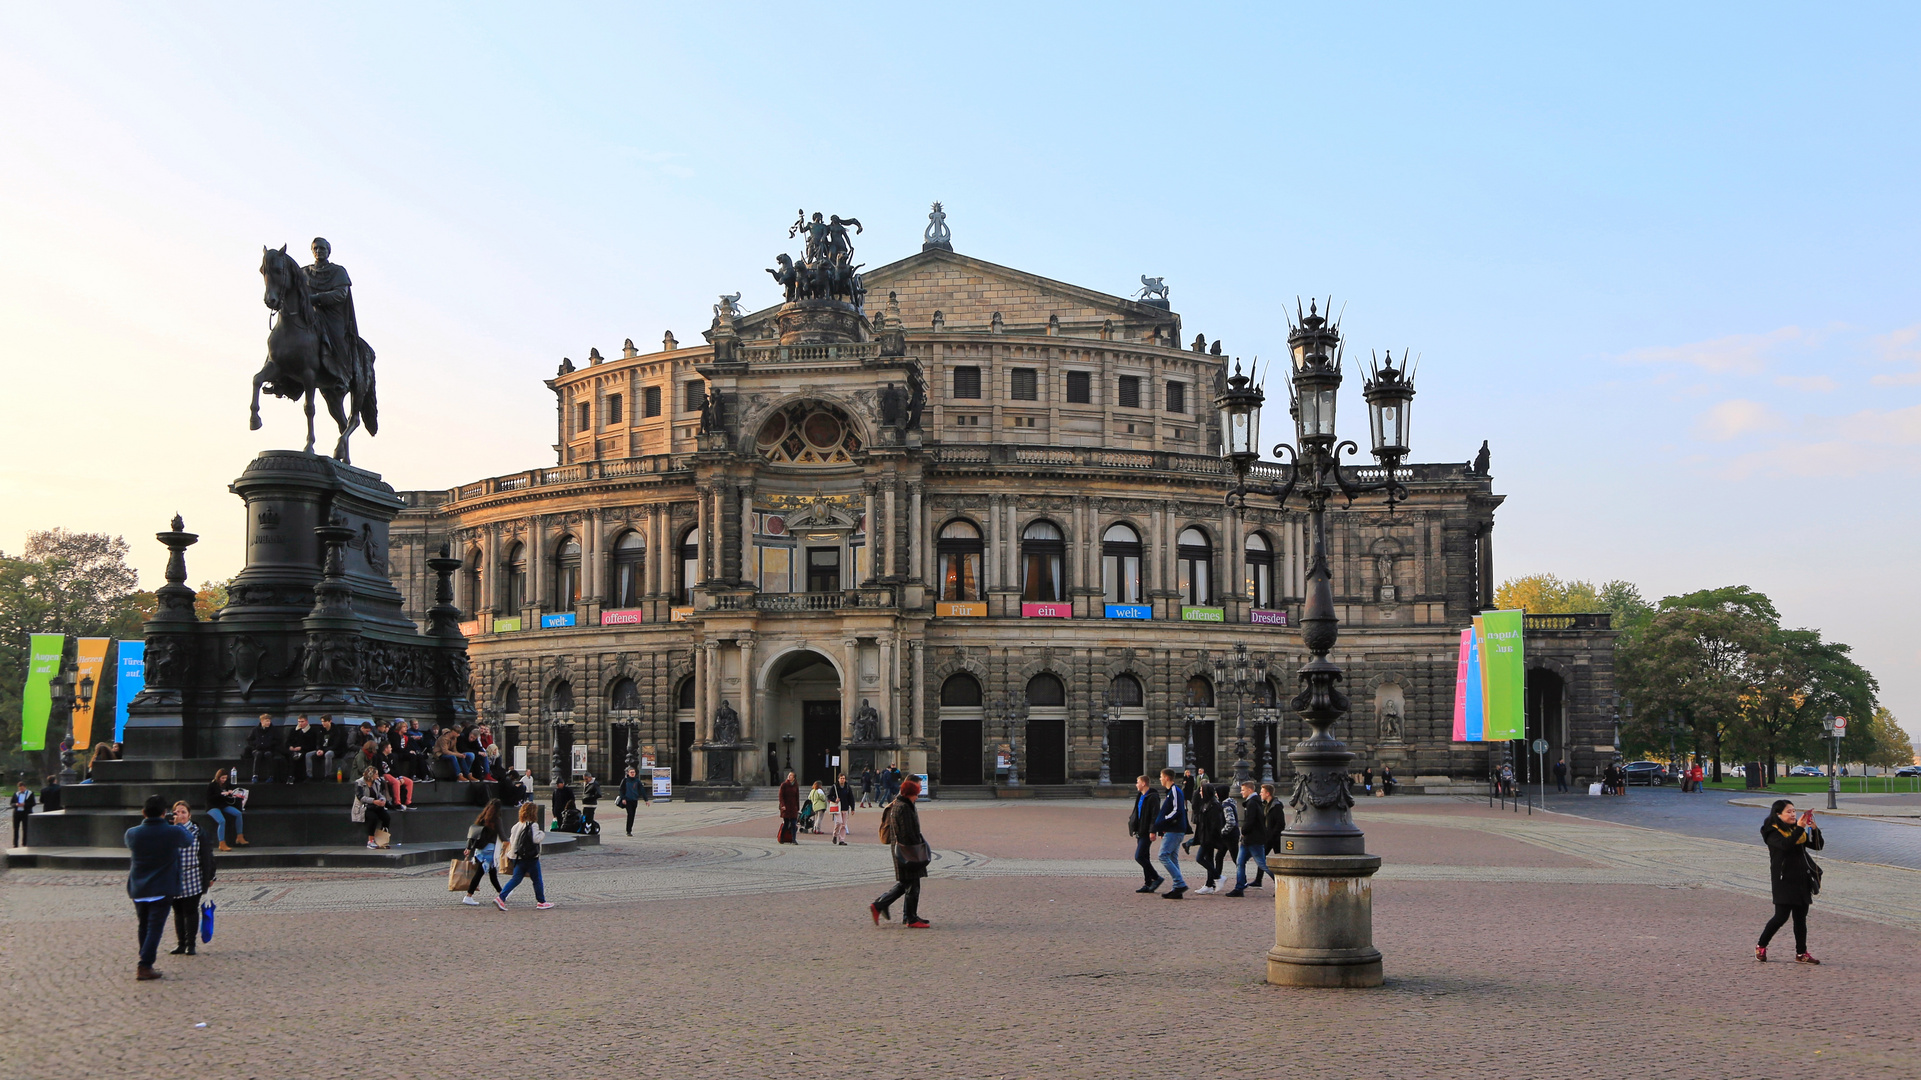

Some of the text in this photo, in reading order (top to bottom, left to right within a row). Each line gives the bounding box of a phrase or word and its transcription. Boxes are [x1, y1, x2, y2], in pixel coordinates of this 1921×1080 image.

[951, 604, 1286, 624] Für ein welt- offenes Dresden
[501, 621, 512, 631] ein
[548, 616, 568, 626] welt-
[605, 613, 638, 624] offenes
[34, 653, 60, 663] Augen
[36, 665, 51, 673] auf.
